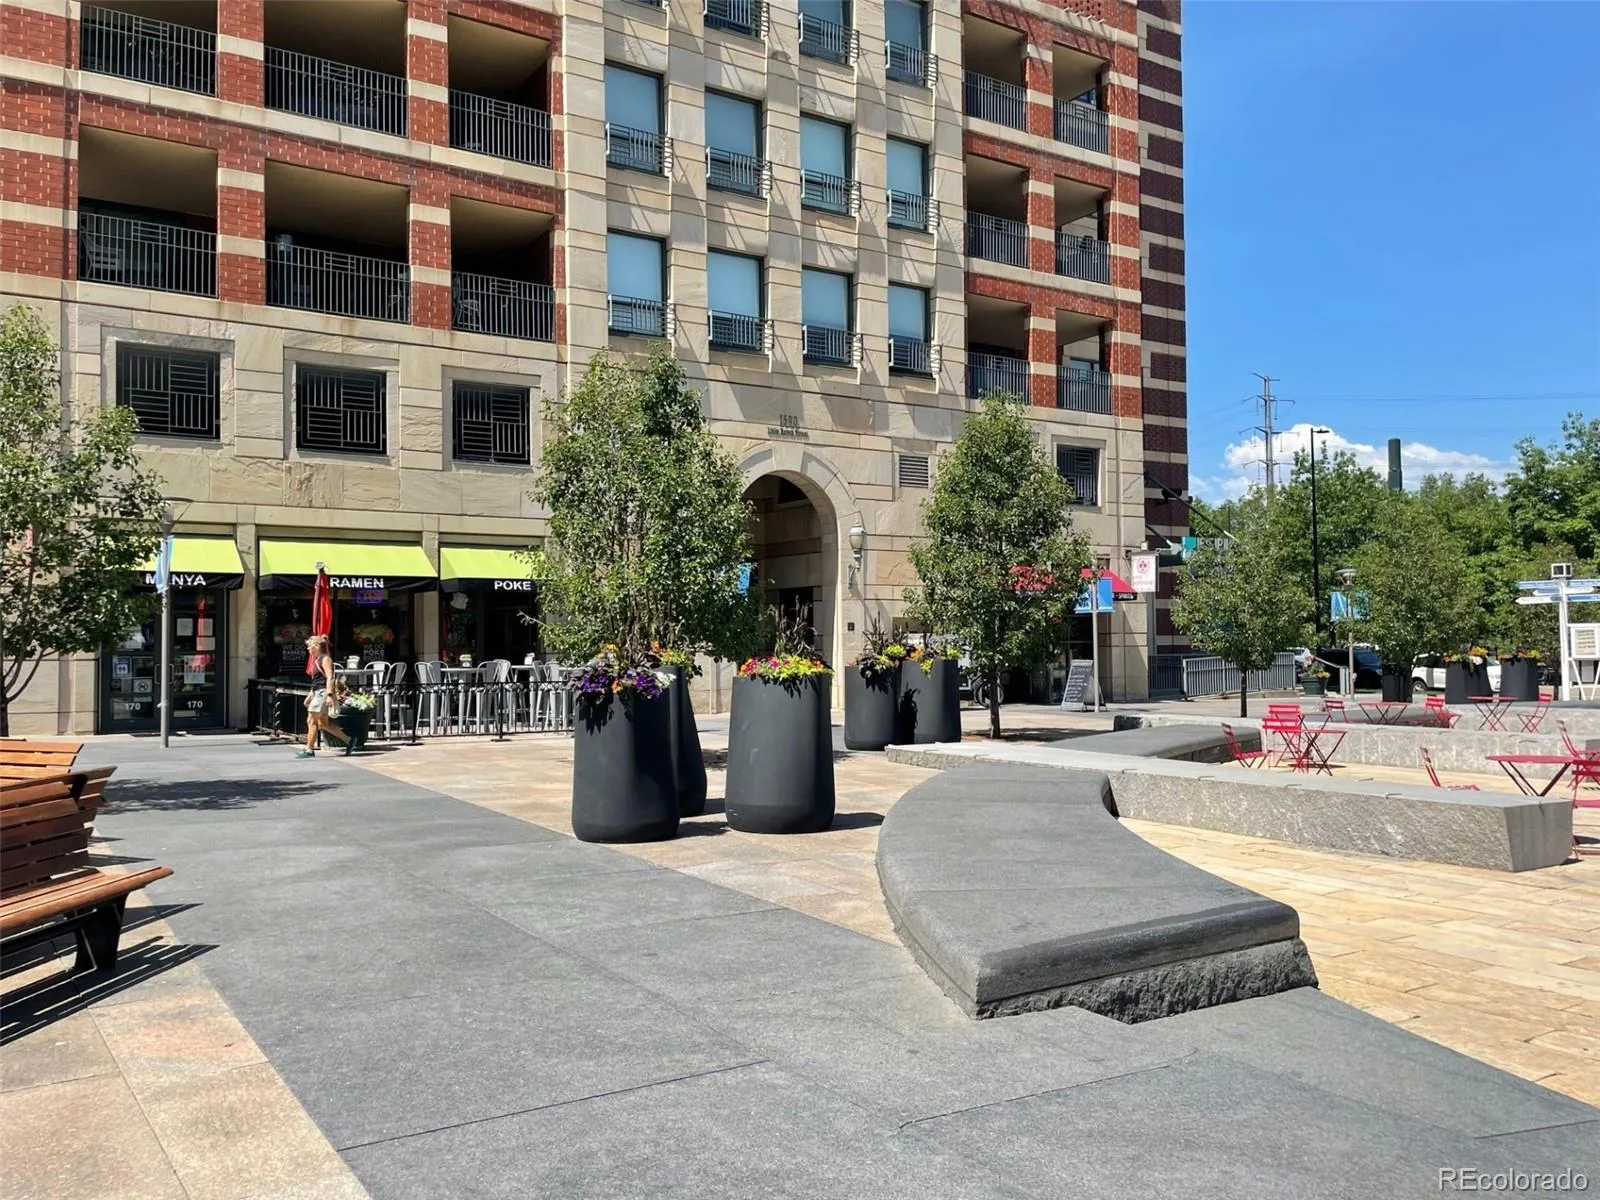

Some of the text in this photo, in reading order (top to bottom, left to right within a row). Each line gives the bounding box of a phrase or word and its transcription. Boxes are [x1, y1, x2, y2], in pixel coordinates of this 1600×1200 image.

[145, 573, 206, 586] MNYA
[329, 577, 384, 588] RAMEN
[494, 580, 532, 591] POKE
[125, 703, 141, 711] 170
[187, 701, 204, 709] 170
